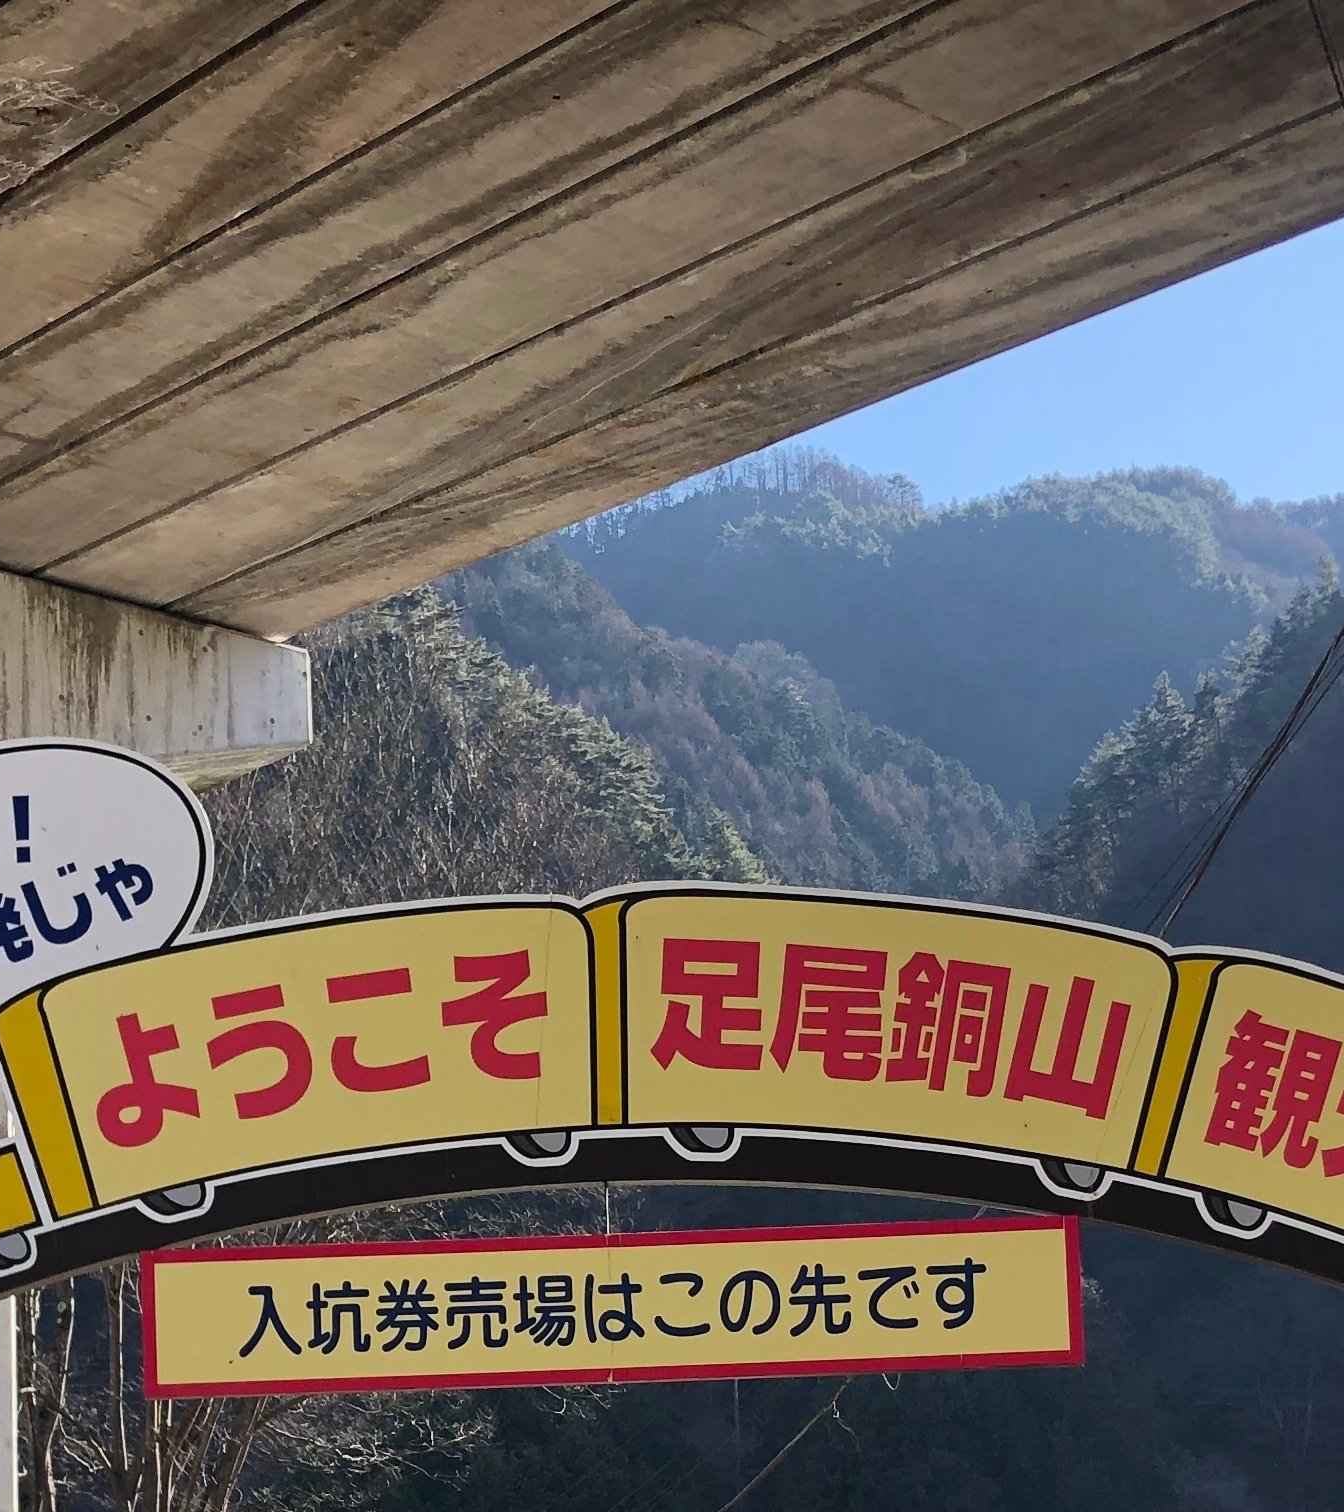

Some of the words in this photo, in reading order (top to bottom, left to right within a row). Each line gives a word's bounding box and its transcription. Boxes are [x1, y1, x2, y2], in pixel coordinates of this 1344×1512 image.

[95, 949, 549, 1148] ようこそ
[650, 937, 1131, 1121] 足尾銅山
[238, 1257, 987, 1358] 入坑券売場はこの先です
